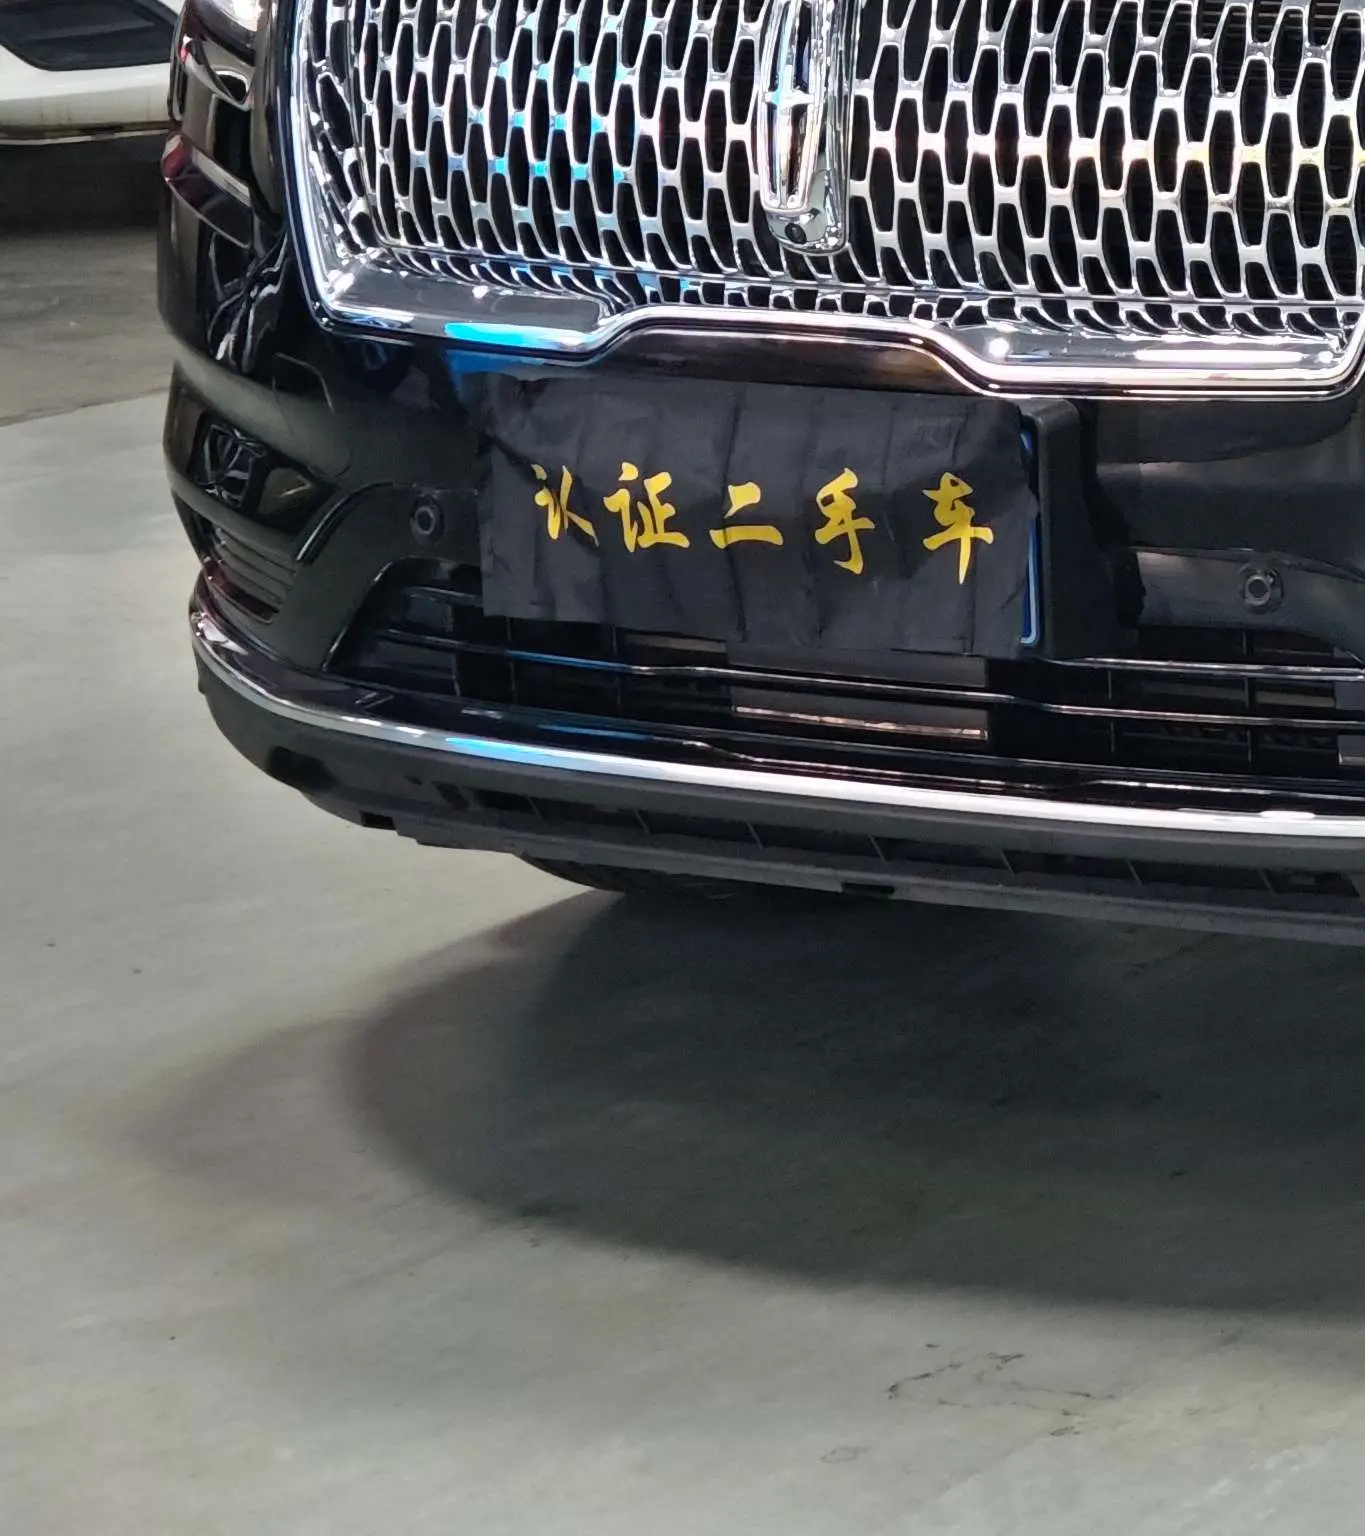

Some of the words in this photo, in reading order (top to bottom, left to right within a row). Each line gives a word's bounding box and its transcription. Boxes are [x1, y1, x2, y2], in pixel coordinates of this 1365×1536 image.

[530, 460, 994, 585] 认证二手车
